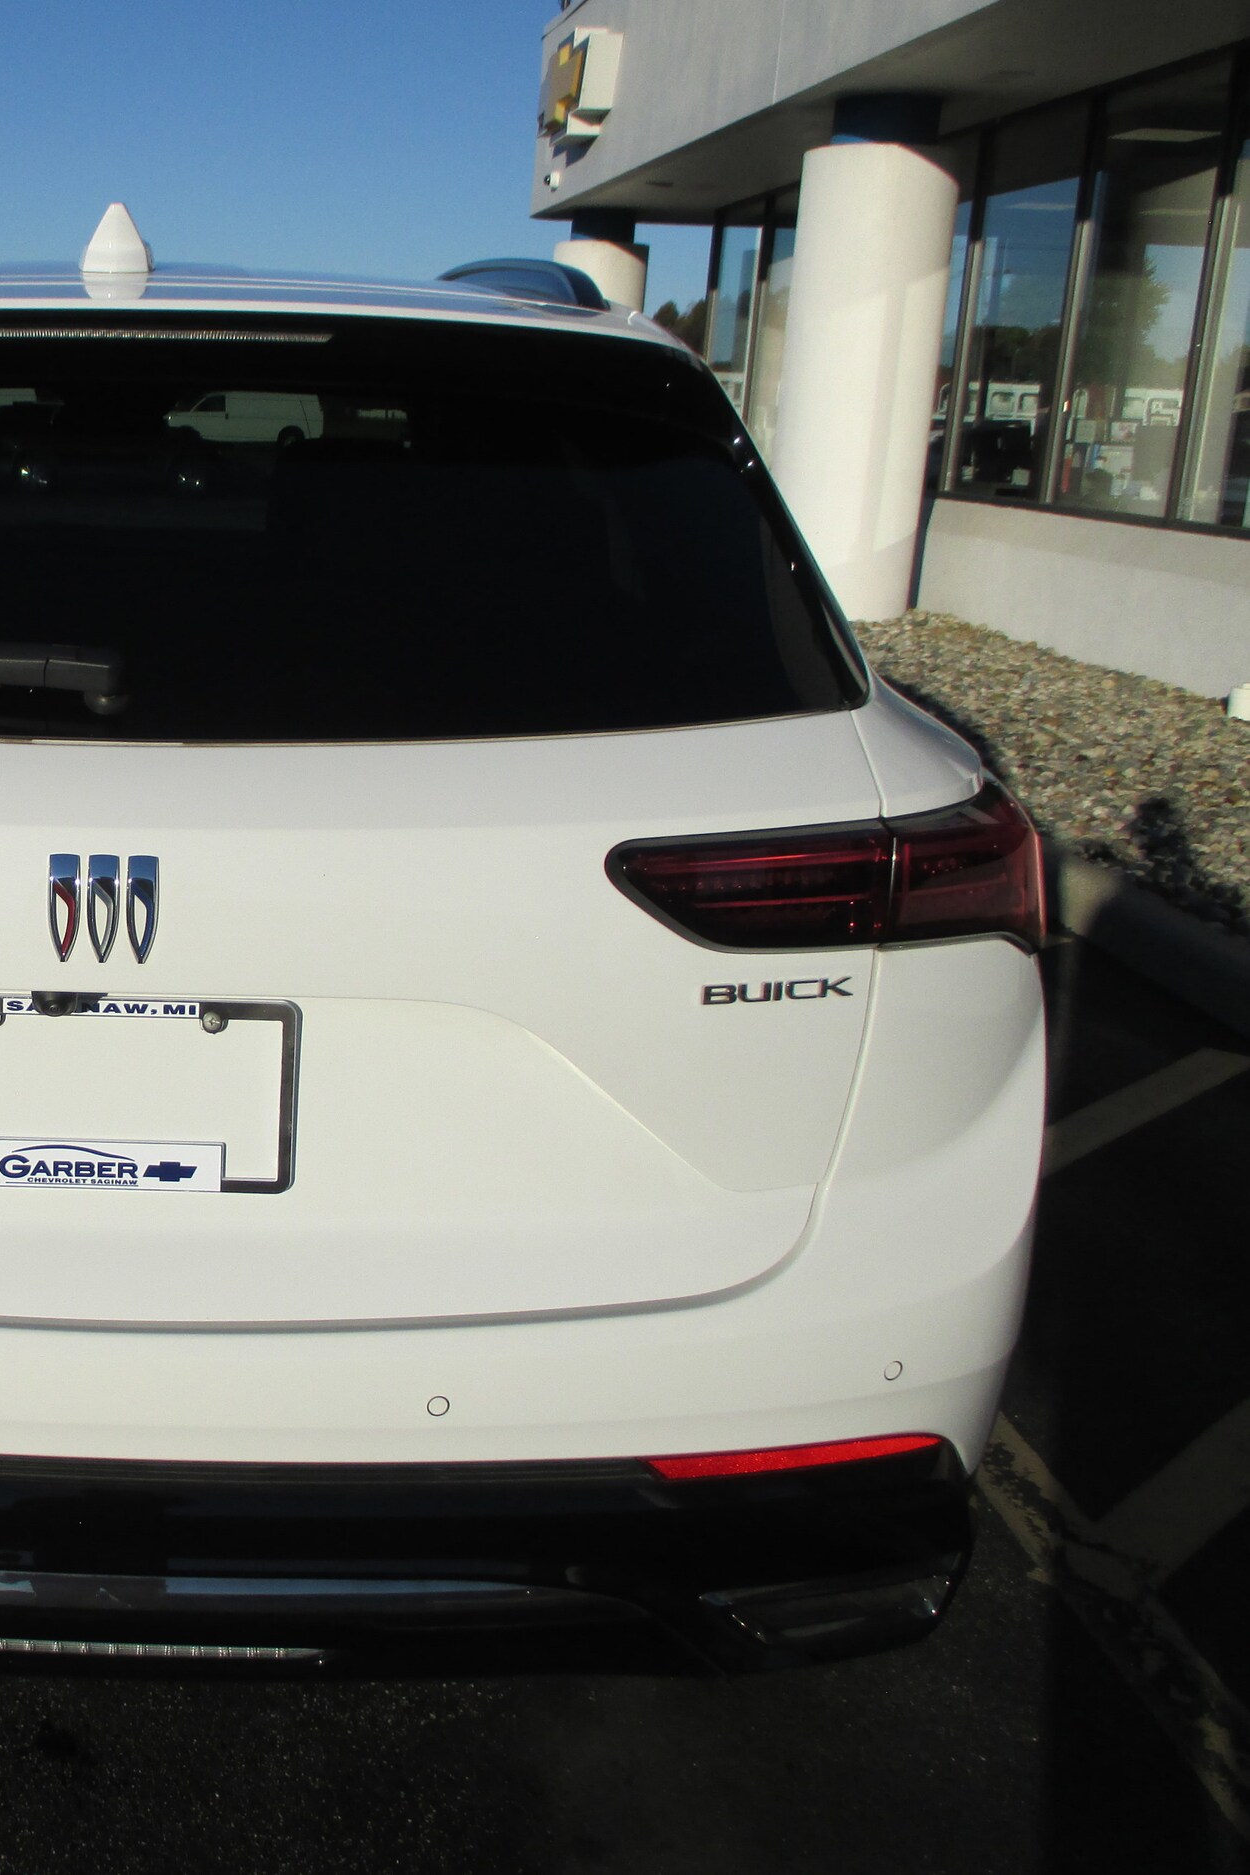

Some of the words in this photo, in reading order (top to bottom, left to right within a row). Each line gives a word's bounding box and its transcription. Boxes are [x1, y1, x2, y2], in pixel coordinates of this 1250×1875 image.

[701, 976, 854, 1006] BUICK
[6, 999, 158, 1016] SNAW,
[162, 1004, 197, 1016] MI
[27, 1177, 88, 1185] CHEVROLET
[90, 1178, 139, 1186] SAGINAW
